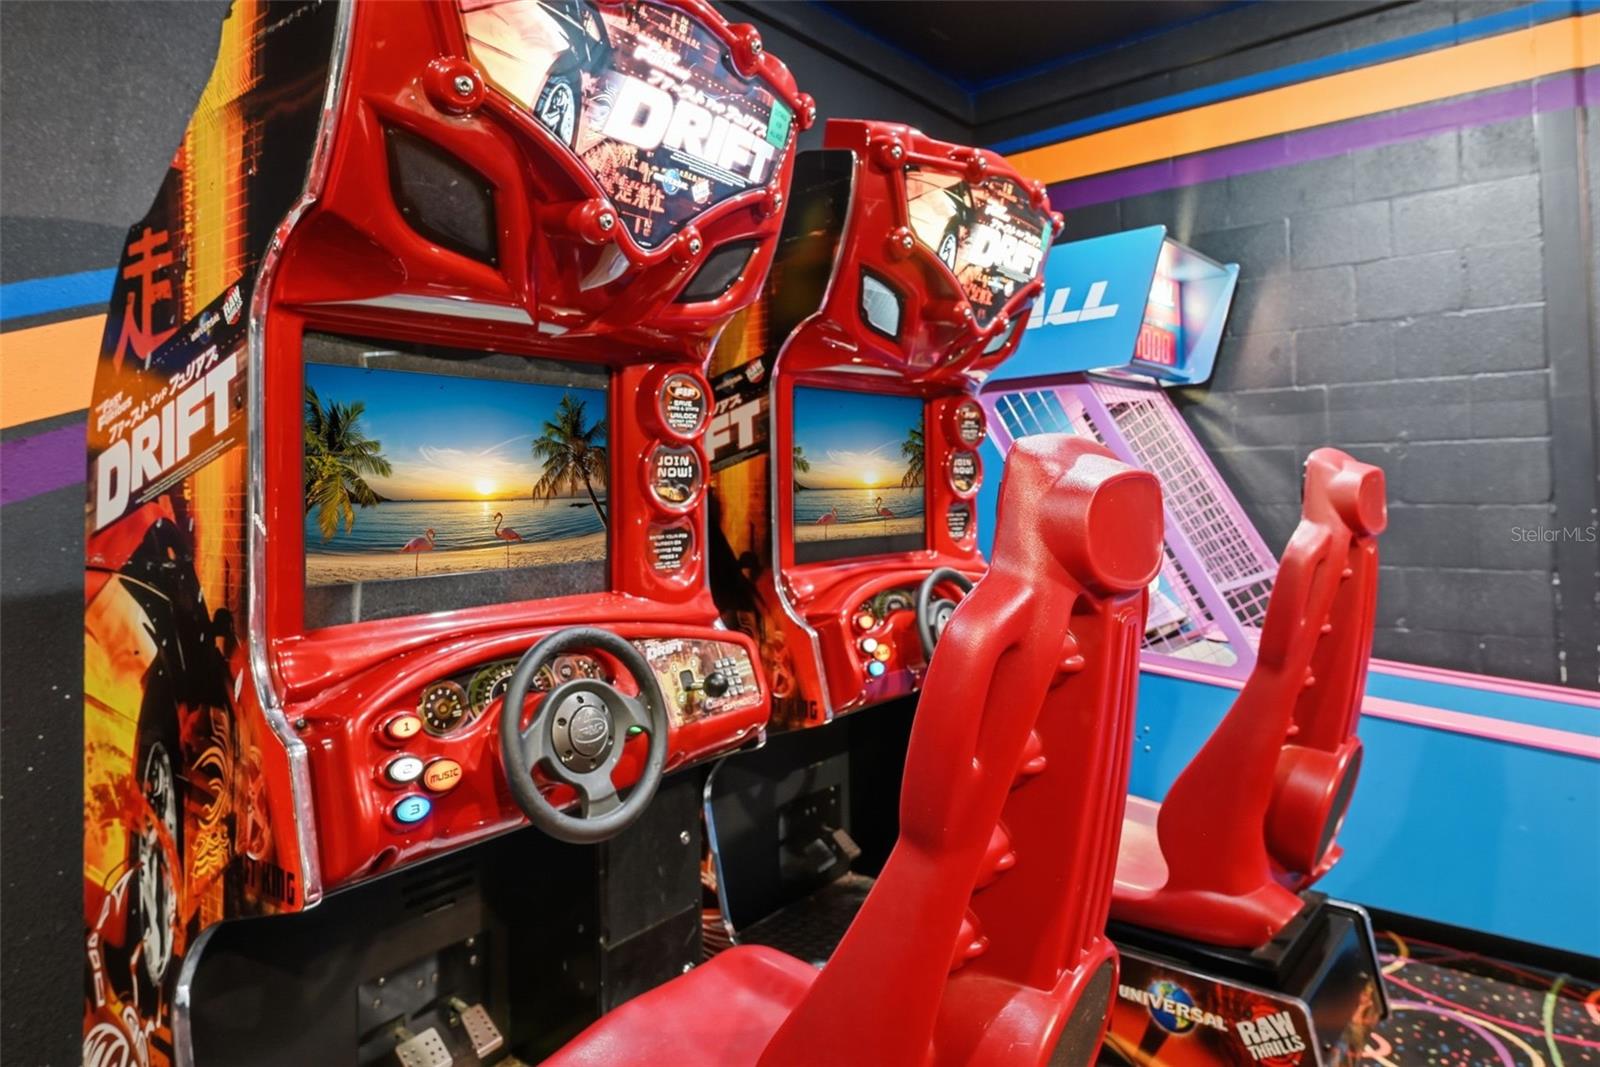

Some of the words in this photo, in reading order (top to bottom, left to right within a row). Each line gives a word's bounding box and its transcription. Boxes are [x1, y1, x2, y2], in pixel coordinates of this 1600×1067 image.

[601, 75, 775, 185] DRIFT
[968, 222, 1044, 279] DRIFT
[96, 352, 238, 531] DRIFT
[657, 456, 690, 467] JOIN
[953, 458, 972, 466] JOIN
[657, 466, 693, 479] NOW!
[403, 722, 410, 731] 1
[402, 764, 413, 775] 2
[430, 768, 459, 784] MUSIC
[410, 804, 420, 815] 3
[1119, 984, 1229, 1032] UNIVERSAL
[1237, 1011, 1296, 1047] RAW
[1247, 1034, 1305, 1061] THRILLS
